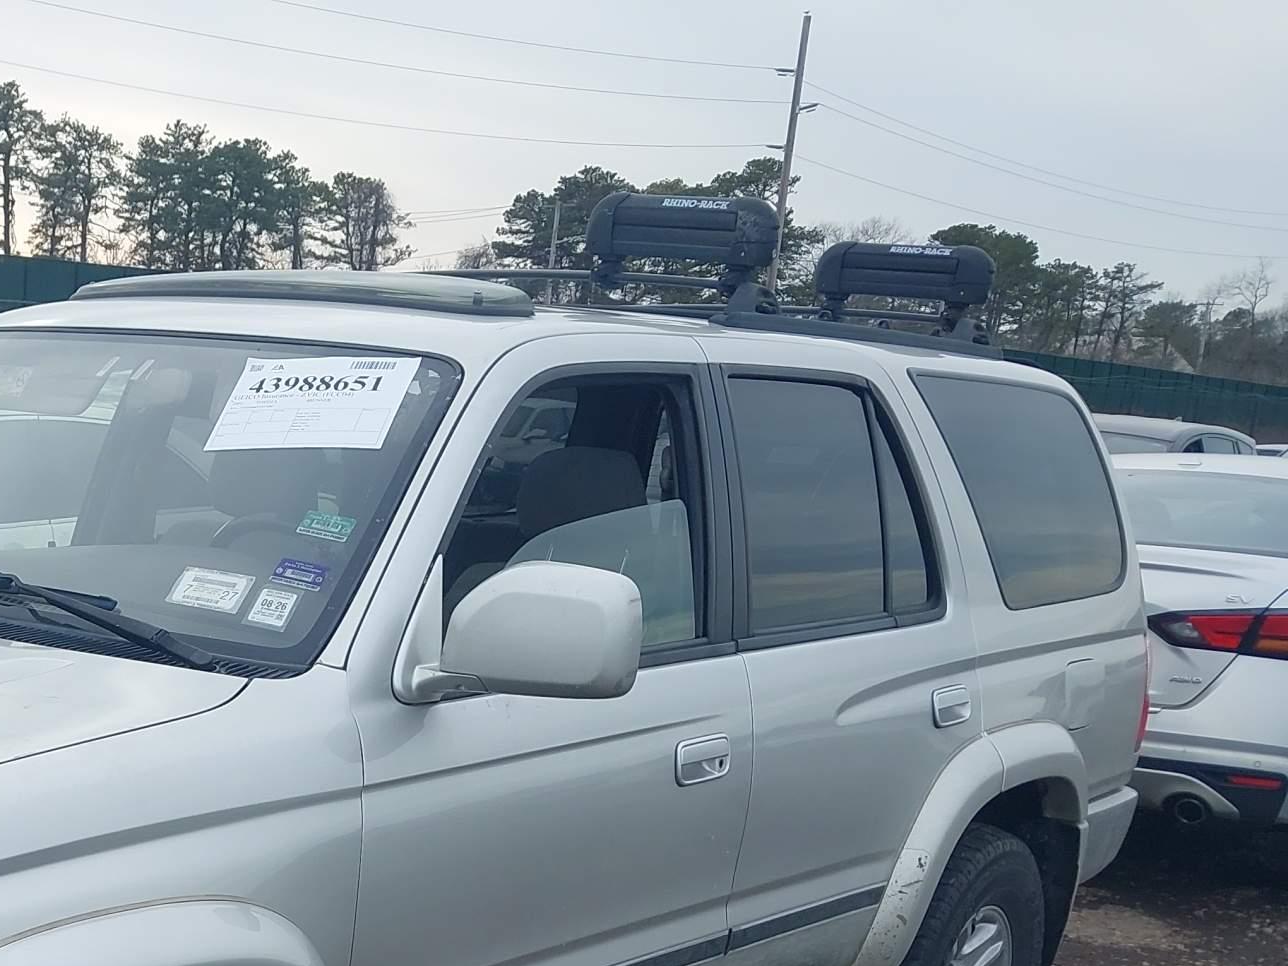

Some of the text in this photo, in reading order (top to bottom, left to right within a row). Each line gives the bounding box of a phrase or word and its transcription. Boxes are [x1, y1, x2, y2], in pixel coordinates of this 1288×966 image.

[662, 198, 730, 209] RHINO-RACK
[889, 246, 953, 256] RHINO-RACK
[249, 376, 383, 393] 43988651
[219, 590, 239, 600] 27
[1225, 593, 1254, 604] SV
